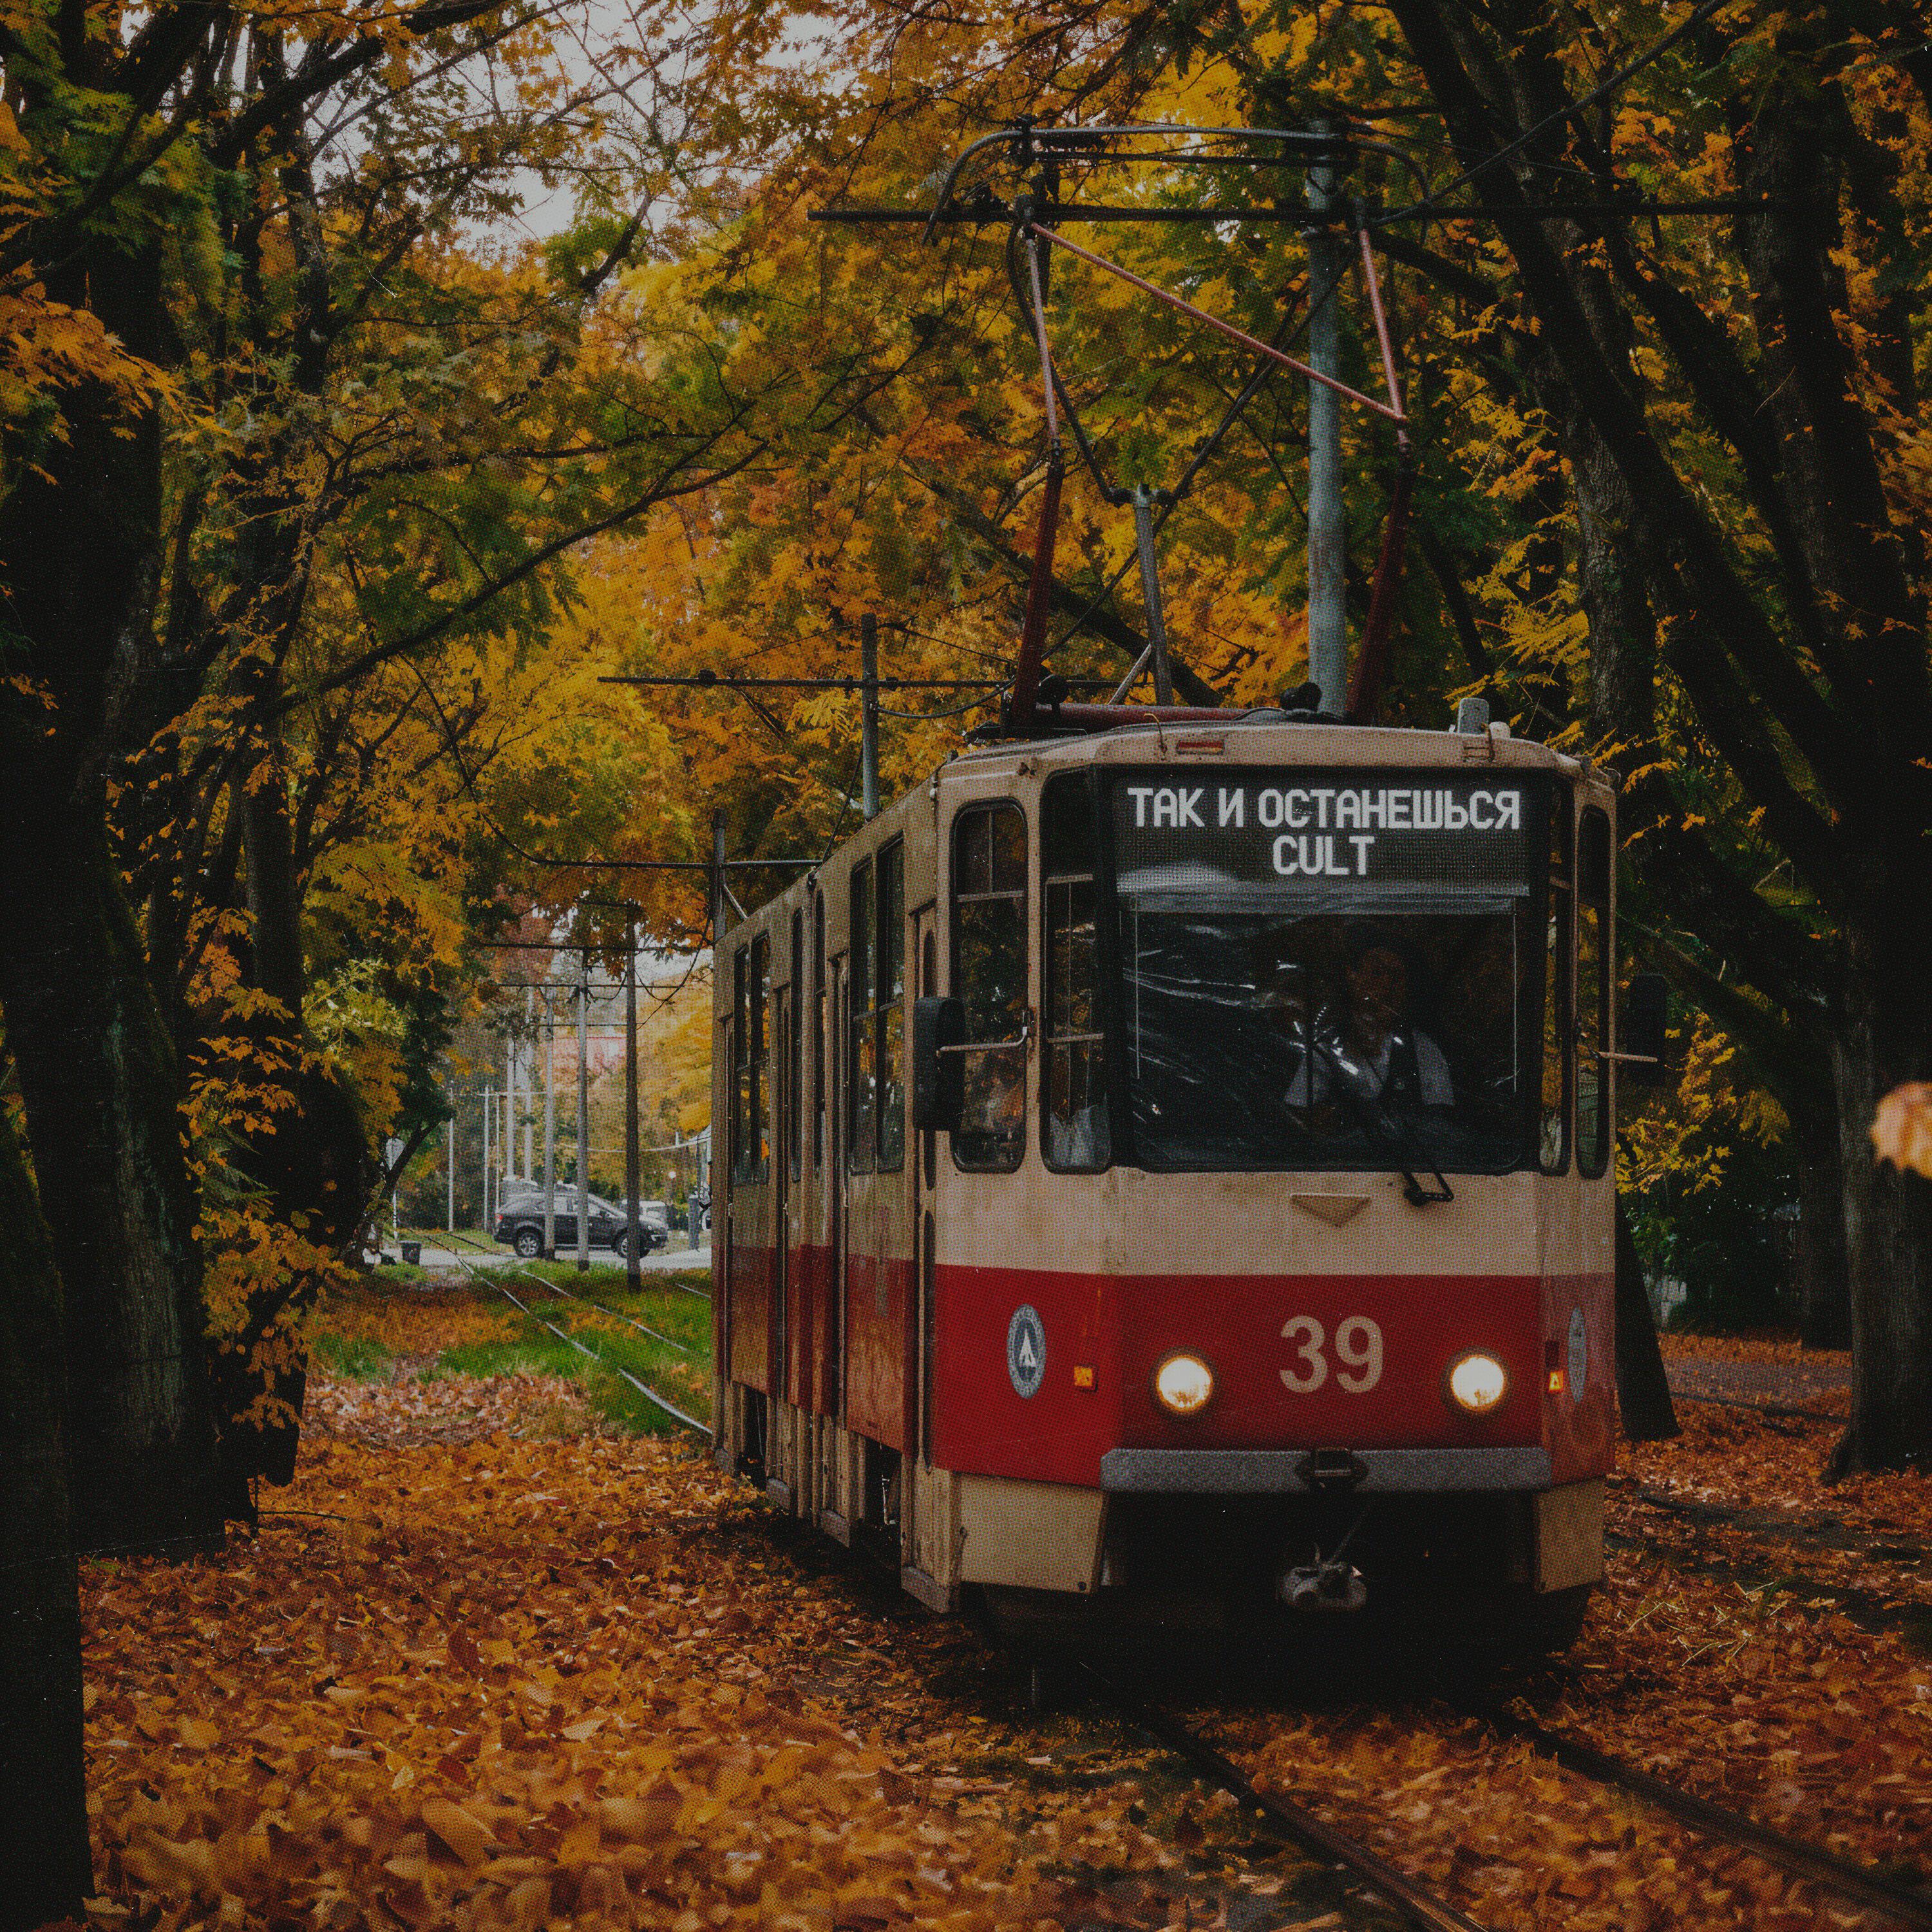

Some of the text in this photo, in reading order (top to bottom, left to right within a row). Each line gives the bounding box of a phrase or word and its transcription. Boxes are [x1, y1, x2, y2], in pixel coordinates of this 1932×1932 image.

[1127, 787, 1520, 830] ТАК И ОСТАНЕШЬСЯ
[1273, 835, 1376, 876] CULT
[1280, 1315, 1384, 1393] 39
